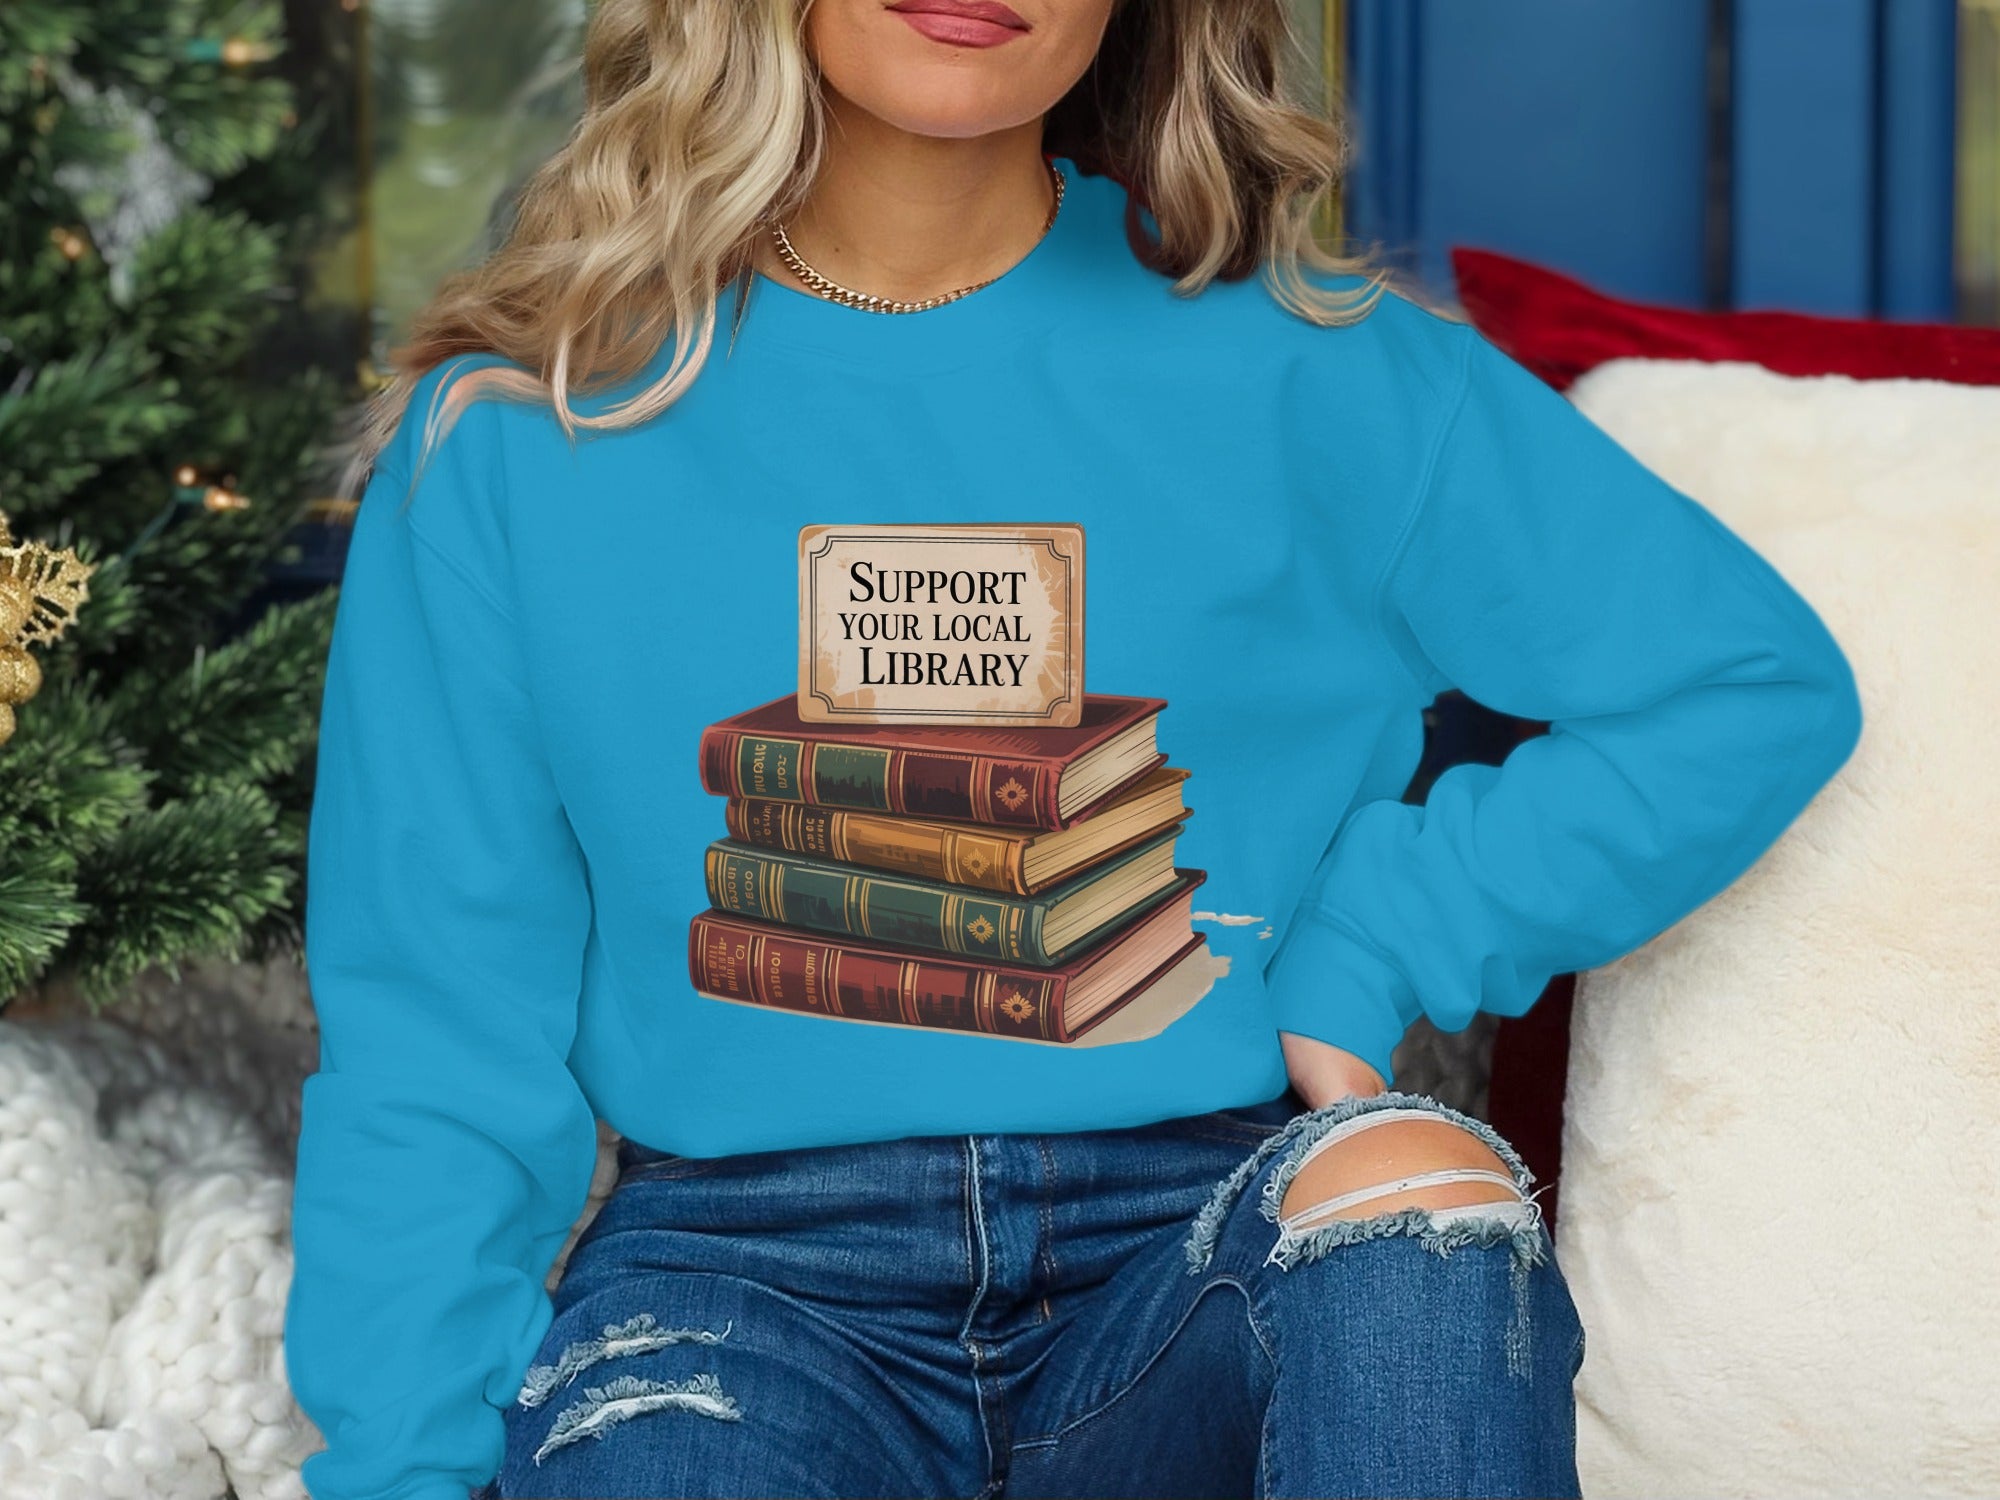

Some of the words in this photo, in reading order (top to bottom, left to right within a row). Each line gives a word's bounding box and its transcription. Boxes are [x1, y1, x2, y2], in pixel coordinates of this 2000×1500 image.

[850, 561, 1026, 604] SUPPORT
[838, 613, 923, 640] YOUR
[932, 614, 1031, 642] LOCAL
[859, 647, 1029, 686] LIBRARY
